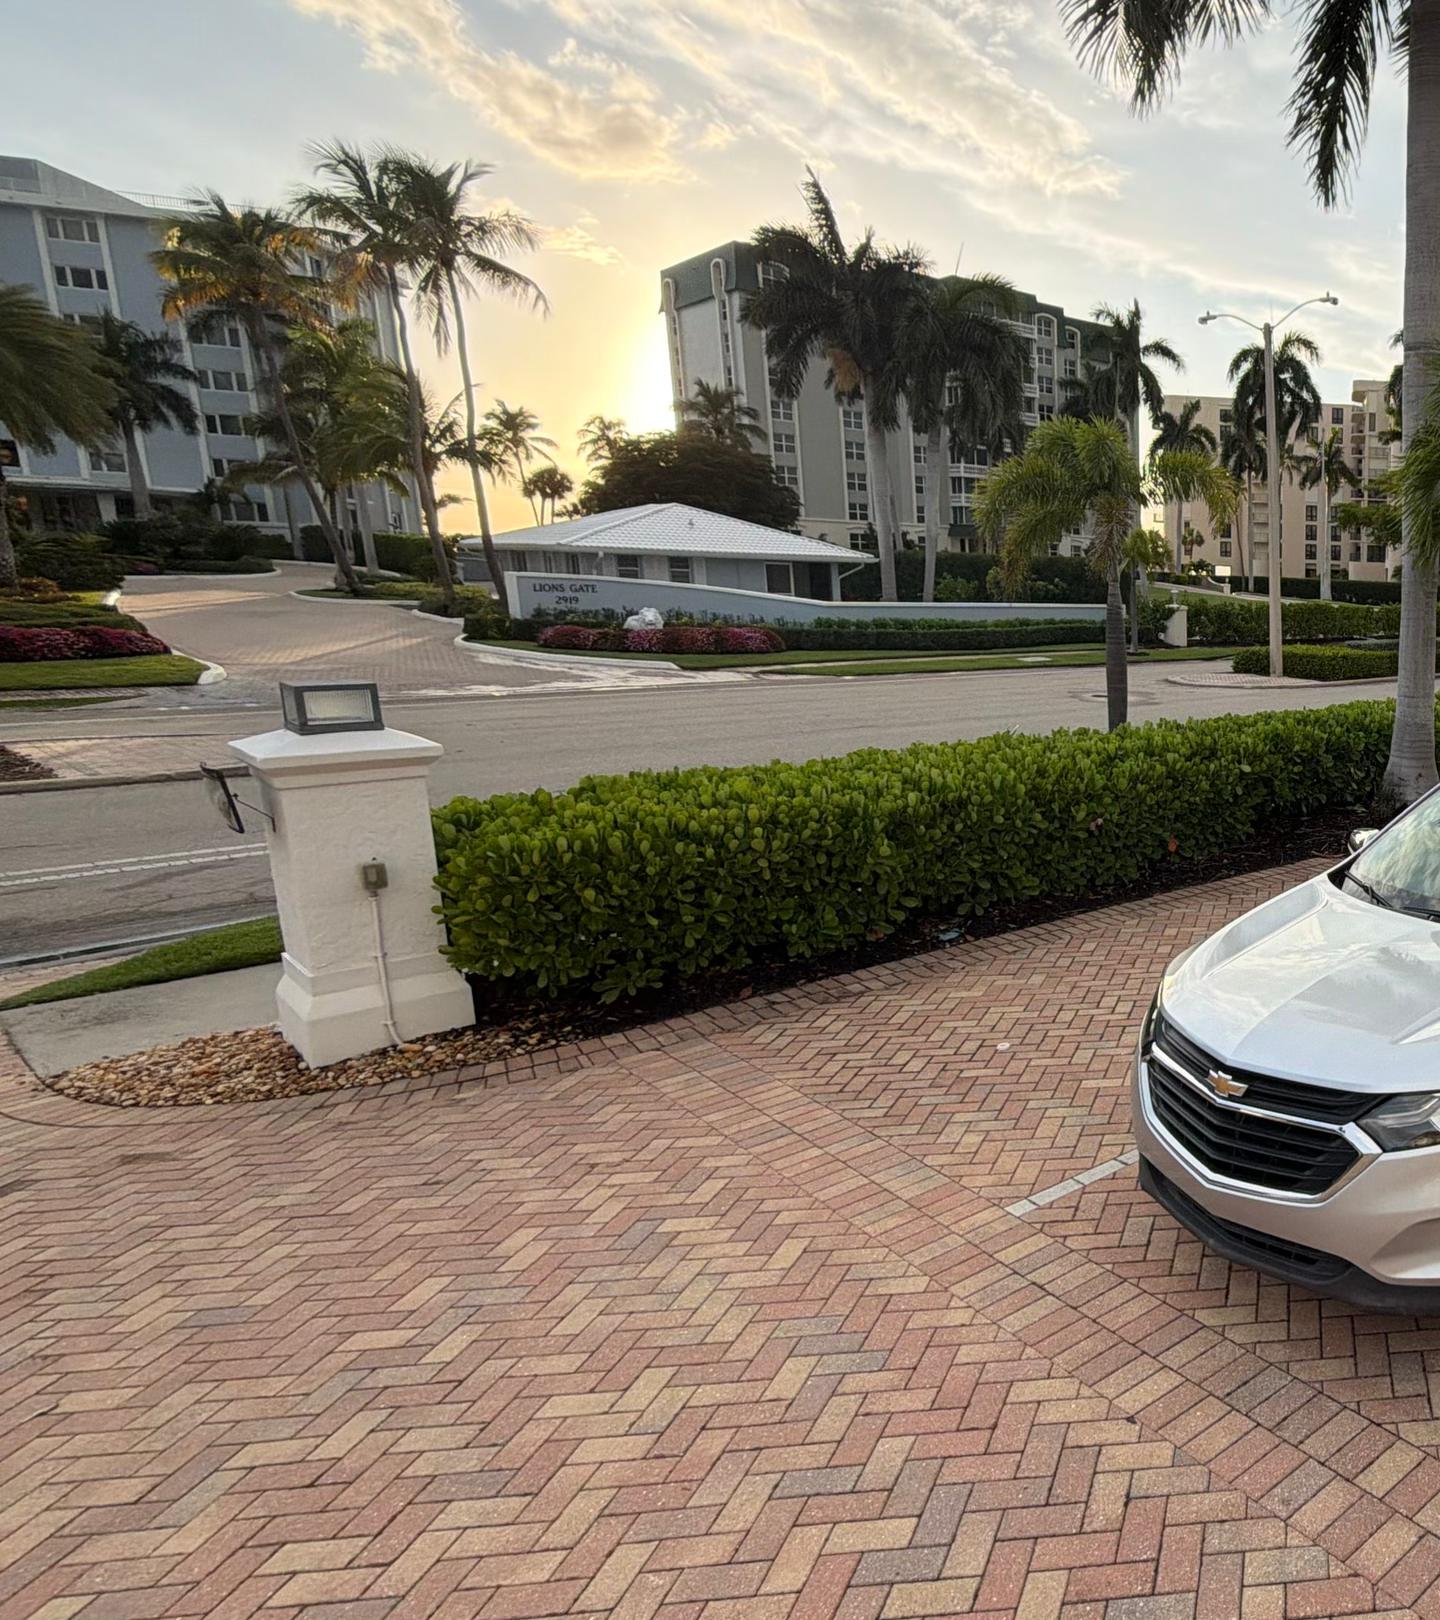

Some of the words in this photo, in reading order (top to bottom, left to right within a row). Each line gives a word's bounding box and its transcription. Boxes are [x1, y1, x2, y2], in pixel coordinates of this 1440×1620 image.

[533, 583, 565, 593] LIONS
[569, 583, 598, 593] GATE
[555, 595, 579, 604] 2919
